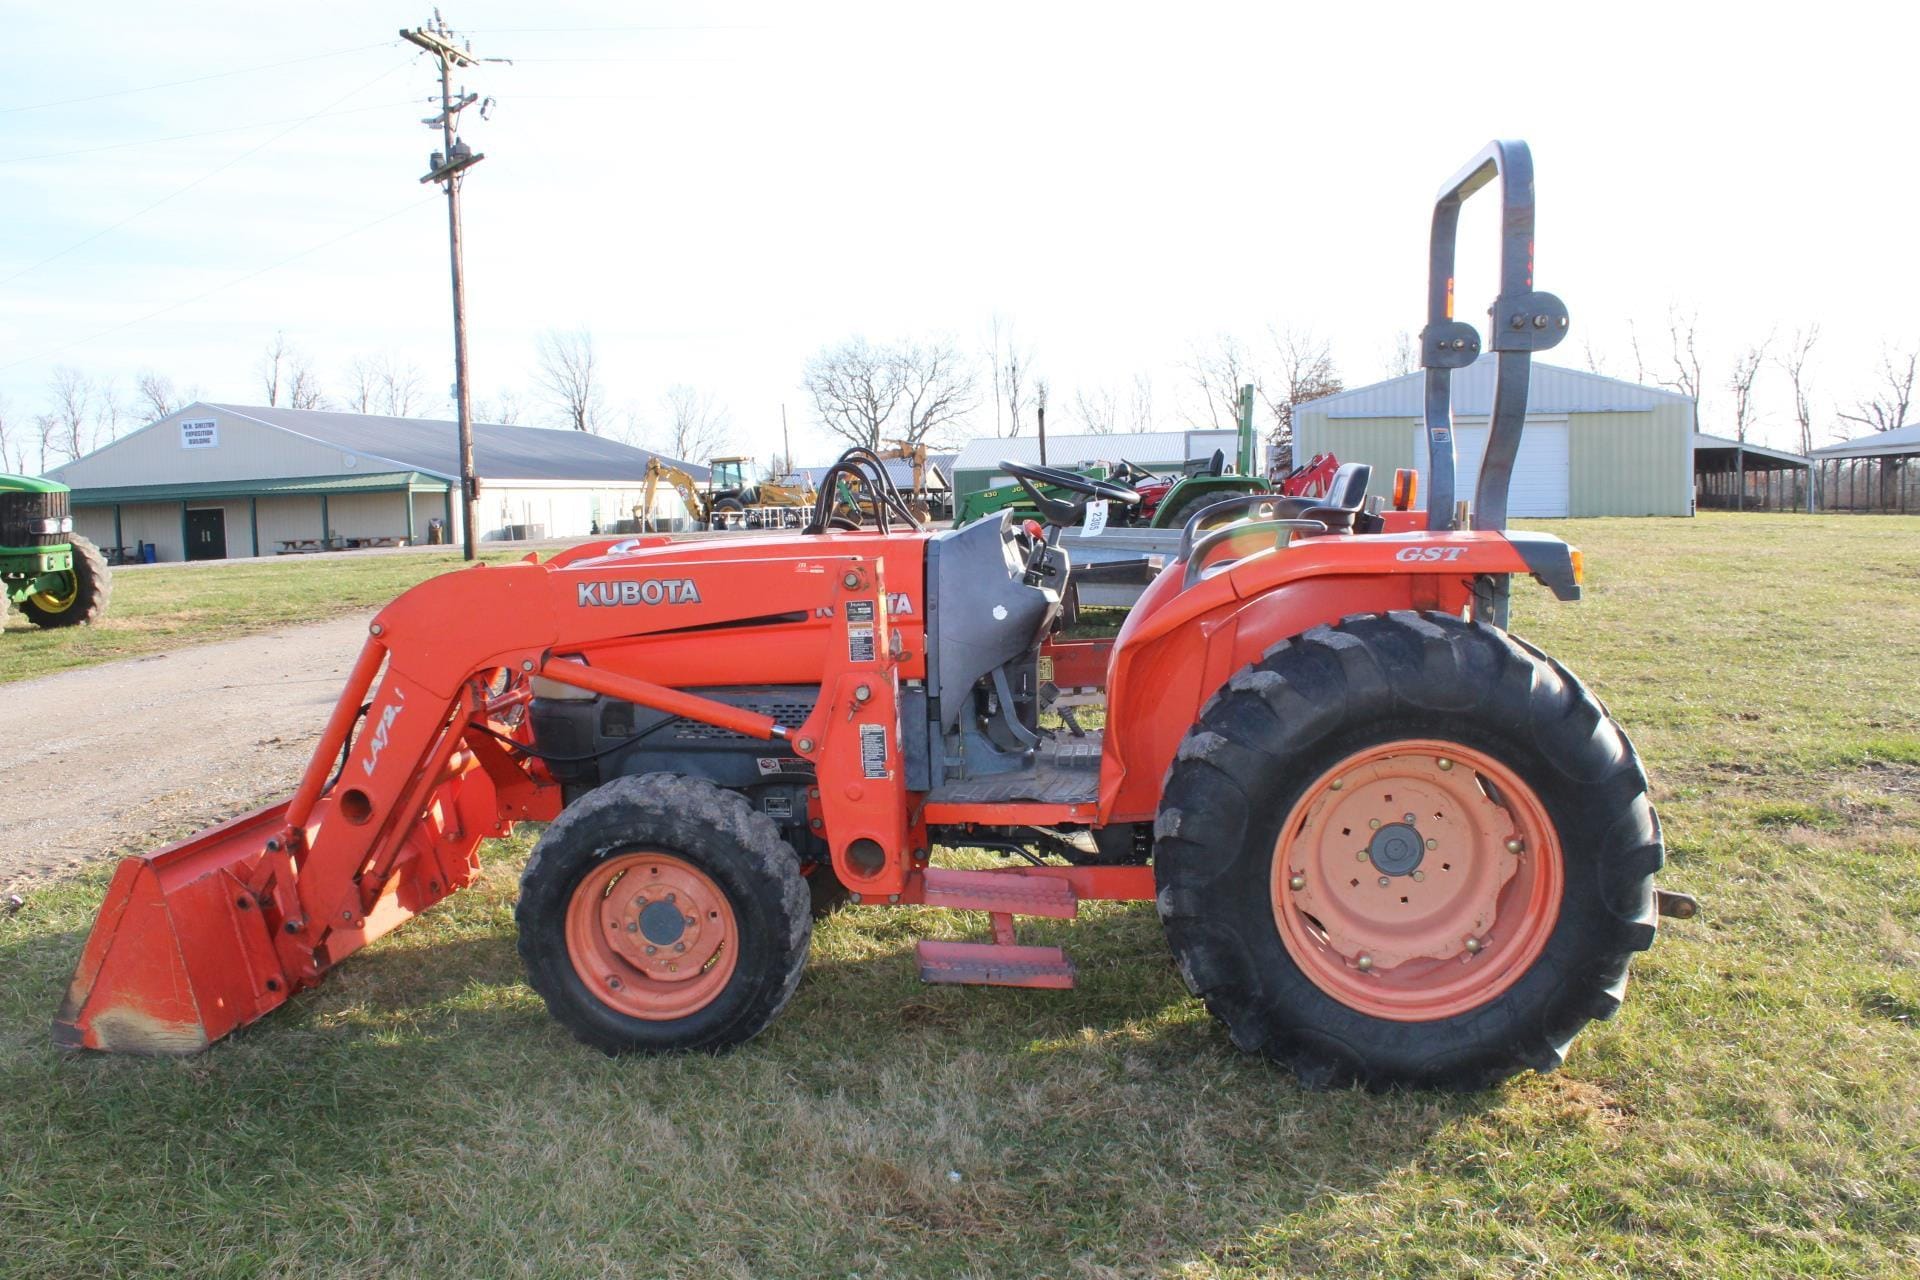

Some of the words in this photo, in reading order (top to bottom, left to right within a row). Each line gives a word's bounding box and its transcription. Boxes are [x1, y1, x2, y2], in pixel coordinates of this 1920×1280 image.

[983, 490, 999, 498] 430
[1395, 546, 1469, 562] GST
[577, 578, 702, 607] KUBOTA
